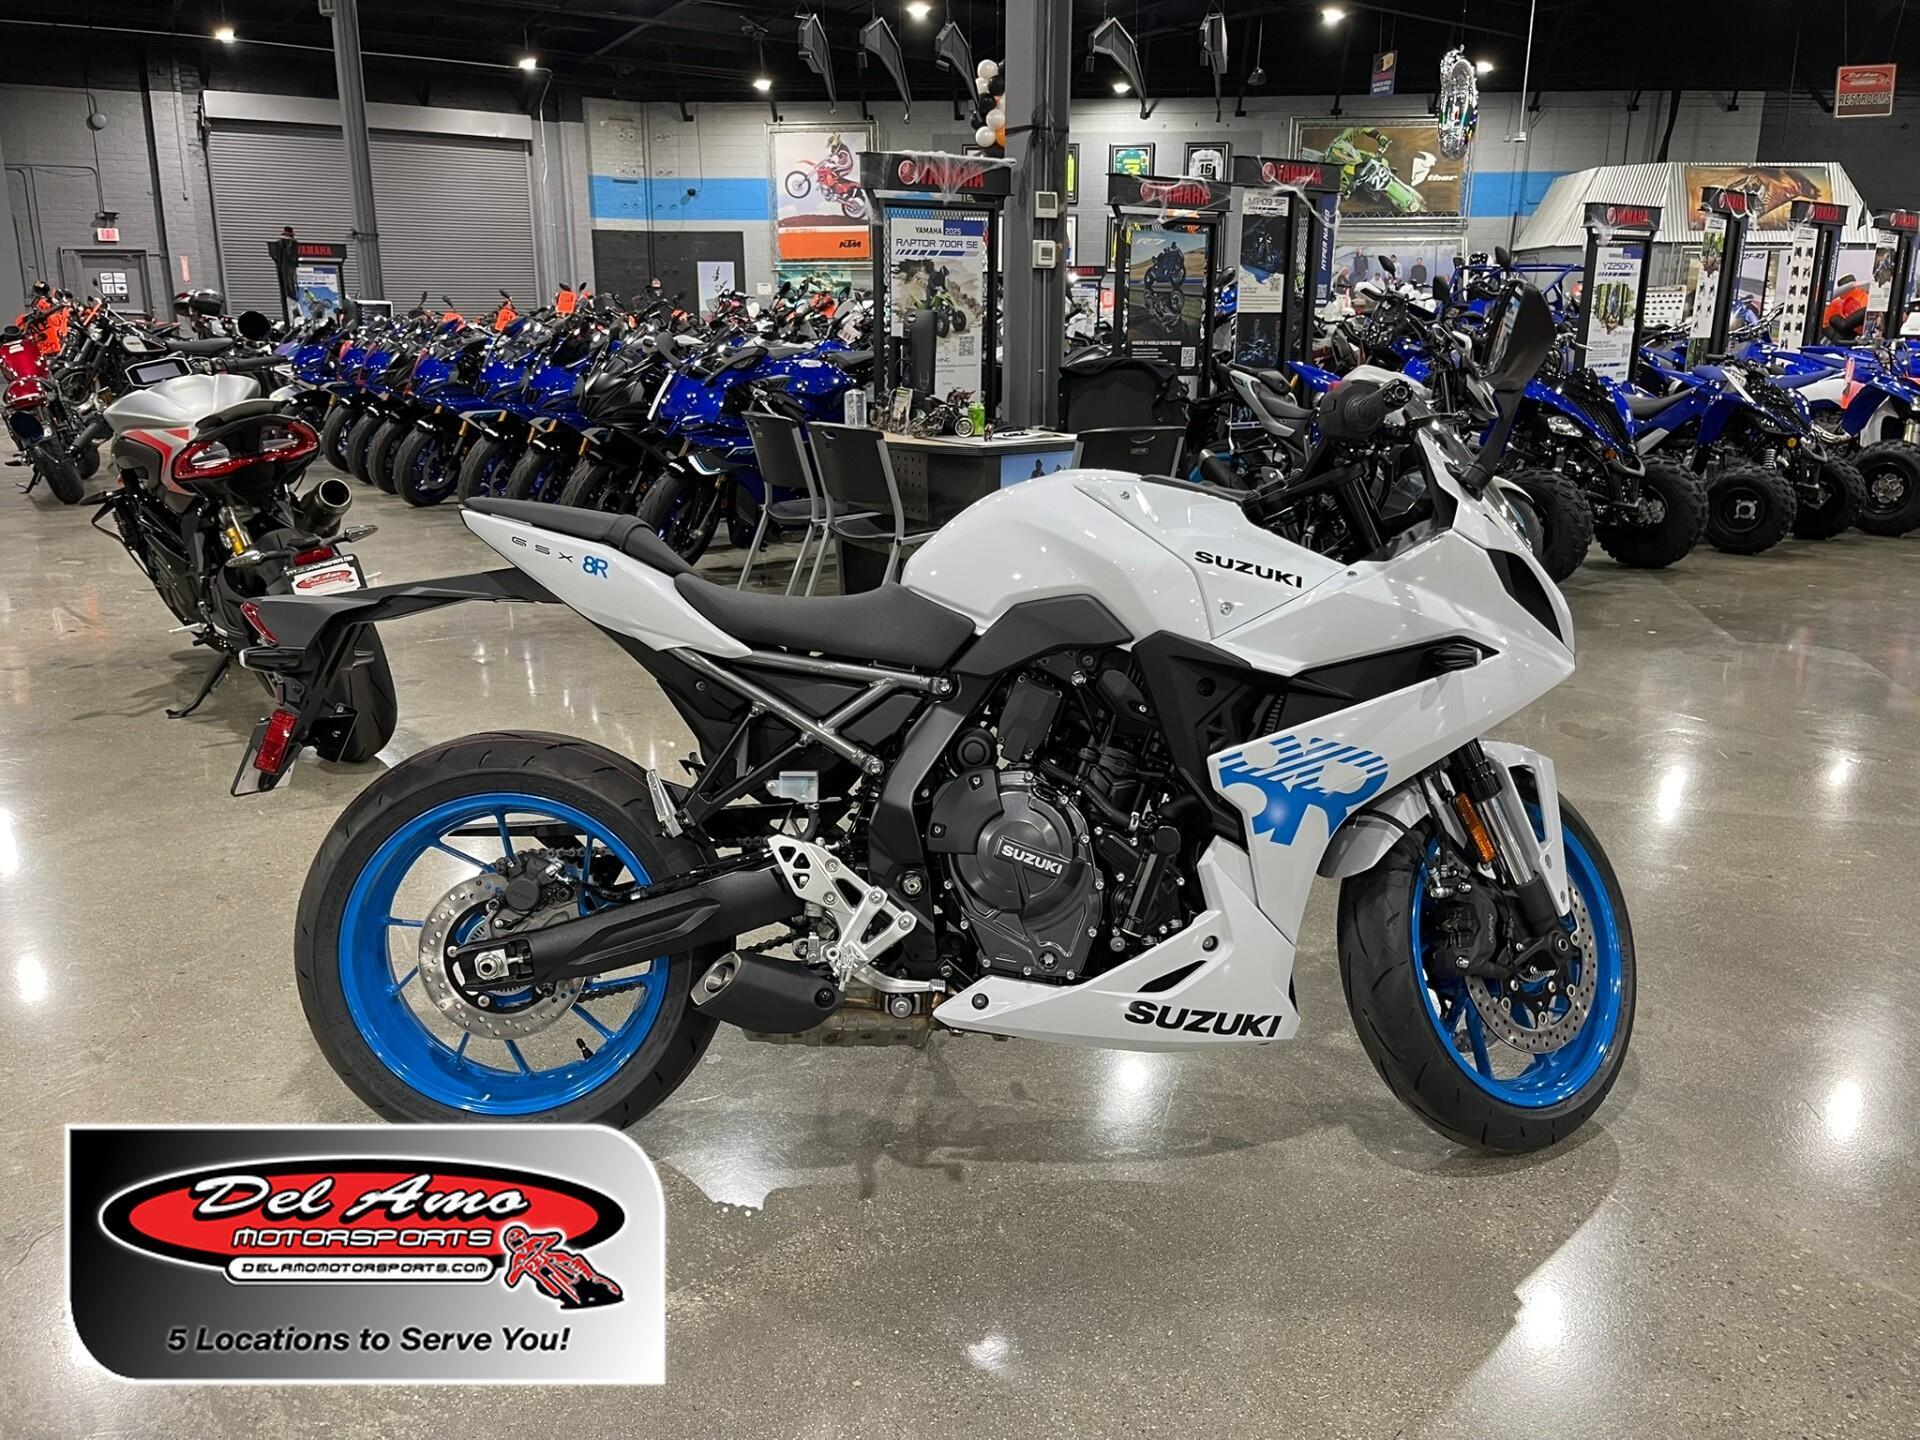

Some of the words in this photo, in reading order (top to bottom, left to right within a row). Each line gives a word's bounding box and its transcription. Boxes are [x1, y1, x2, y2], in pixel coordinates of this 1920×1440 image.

[1840, 92, 1892, 105] RESTROOMS
[1200, 163, 1212, 174] 16
[1276, 163, 1323, 184] YAMAHA
[1616, 207, 1649, 225] YAMAHA
[915, 226, 942, 234] YAMAHA
[839, 240, 861, 248] KTM
[896, 238, 936, 248] RAPTOR
[939, 239, 963, 249] 700R
[966, 240, 979, 249] SE
[1321, 240, 1329, 271] HYPER
[583, 555, 608, 579] 8R
[1194, 551, 1302, 588] SUZUKI
[1001, 844, 1063, 875] SUZUKI
[1124, 1000, 1283, 1038] SUZUKI
